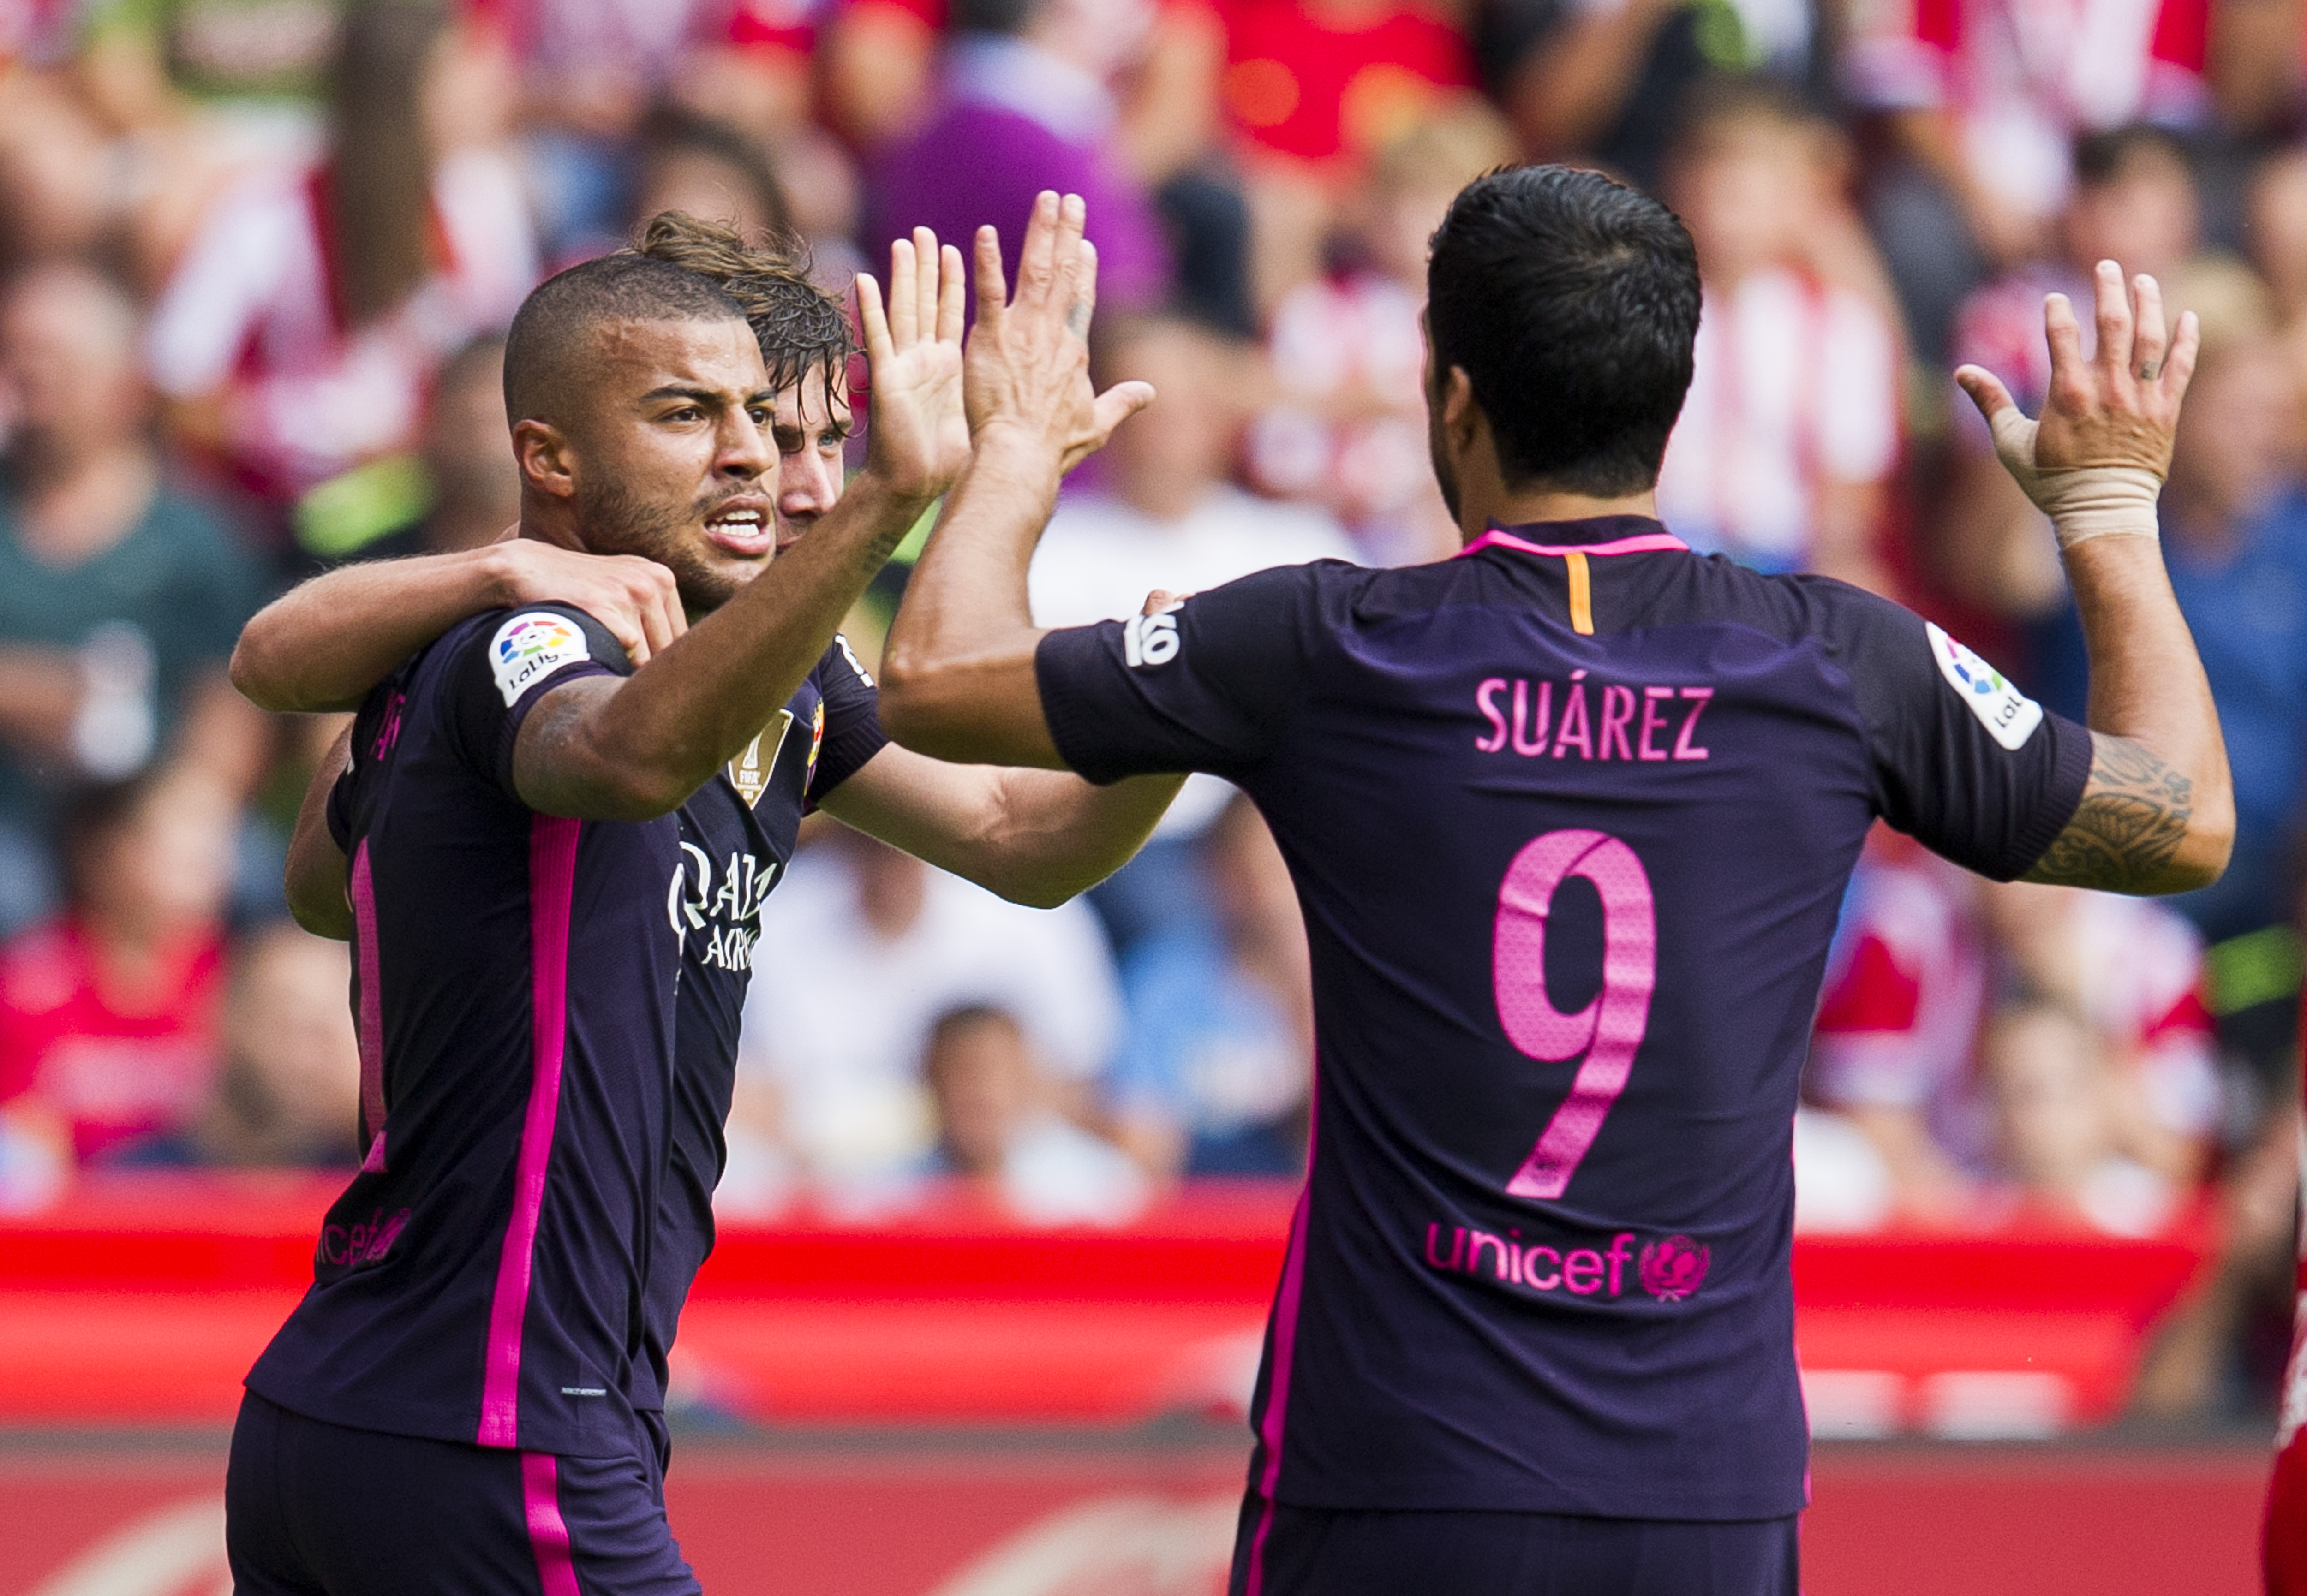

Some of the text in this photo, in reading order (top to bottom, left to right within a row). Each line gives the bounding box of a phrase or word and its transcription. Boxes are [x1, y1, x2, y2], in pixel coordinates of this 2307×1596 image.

[508, 652, 560, 690] LaLig
[1476, 669, 1715, 761] SUÁREZ
[1994, 696, 2023, 728] LaL
[1492, 829, 1656, 1199] 9
[1425, 1221, 1635, 1297] unicef
